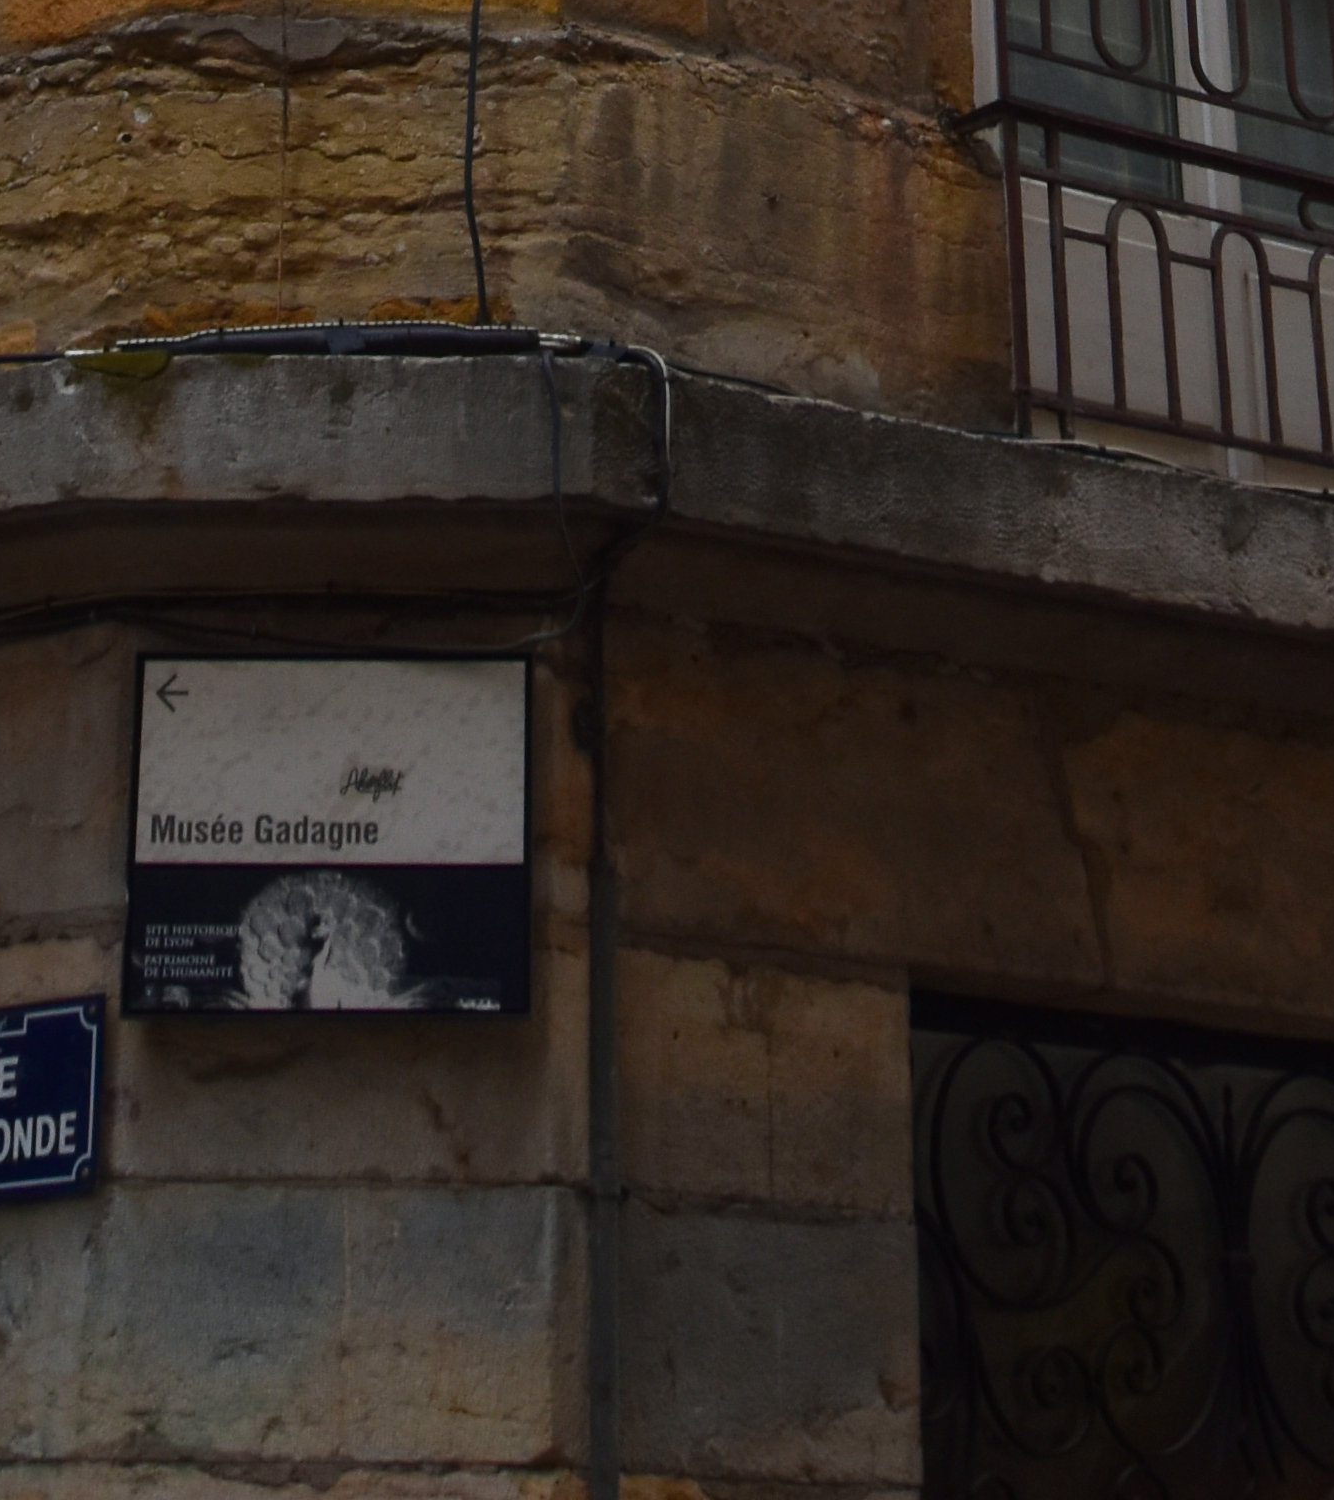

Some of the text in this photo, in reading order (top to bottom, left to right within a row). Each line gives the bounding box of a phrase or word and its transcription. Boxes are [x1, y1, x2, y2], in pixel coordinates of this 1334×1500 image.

[150, 814, 379, 851] Musée Gadagne
[145, 924, 169, 936] SITE
[144, 937, 195, 948] DE LYON
[144, 954, 216, 966] PATRIMOINE
[143, 966, 159, 978] DE
